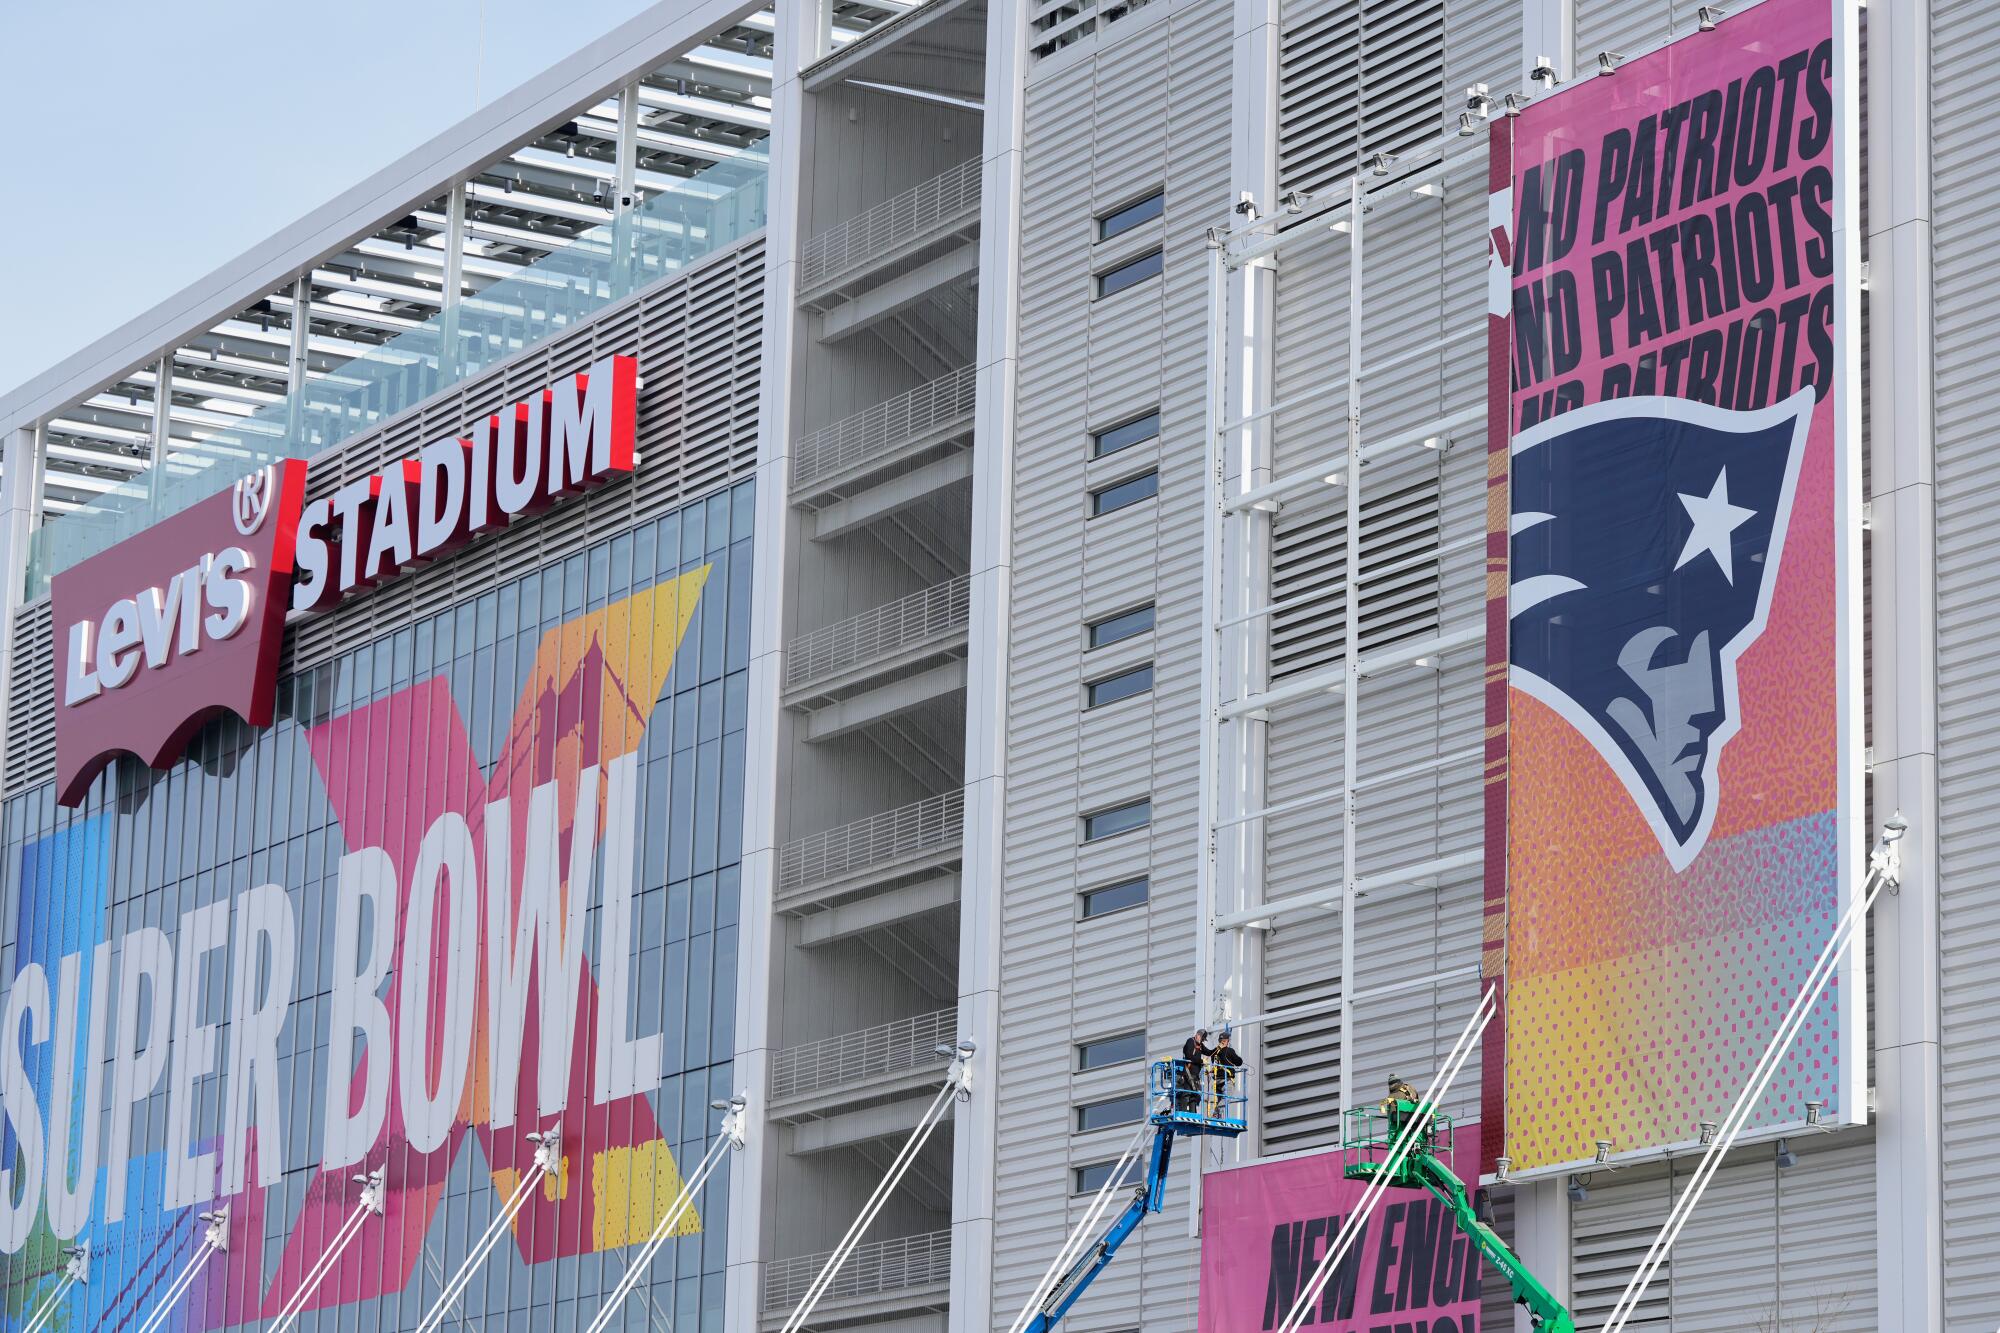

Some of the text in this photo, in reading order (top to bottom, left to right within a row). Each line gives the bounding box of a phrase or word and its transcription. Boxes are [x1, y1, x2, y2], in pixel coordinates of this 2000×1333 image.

[1512, 37, 1833, 277] ND PATRIOTS
[1512, 165, 1833, 393] ND PATRIOTS
[293, 354, 618, 612] STADIUM
[0, 751, 663, 1254] SUPER BOWL
[1262, 1210, 1370, 1332] NEW
